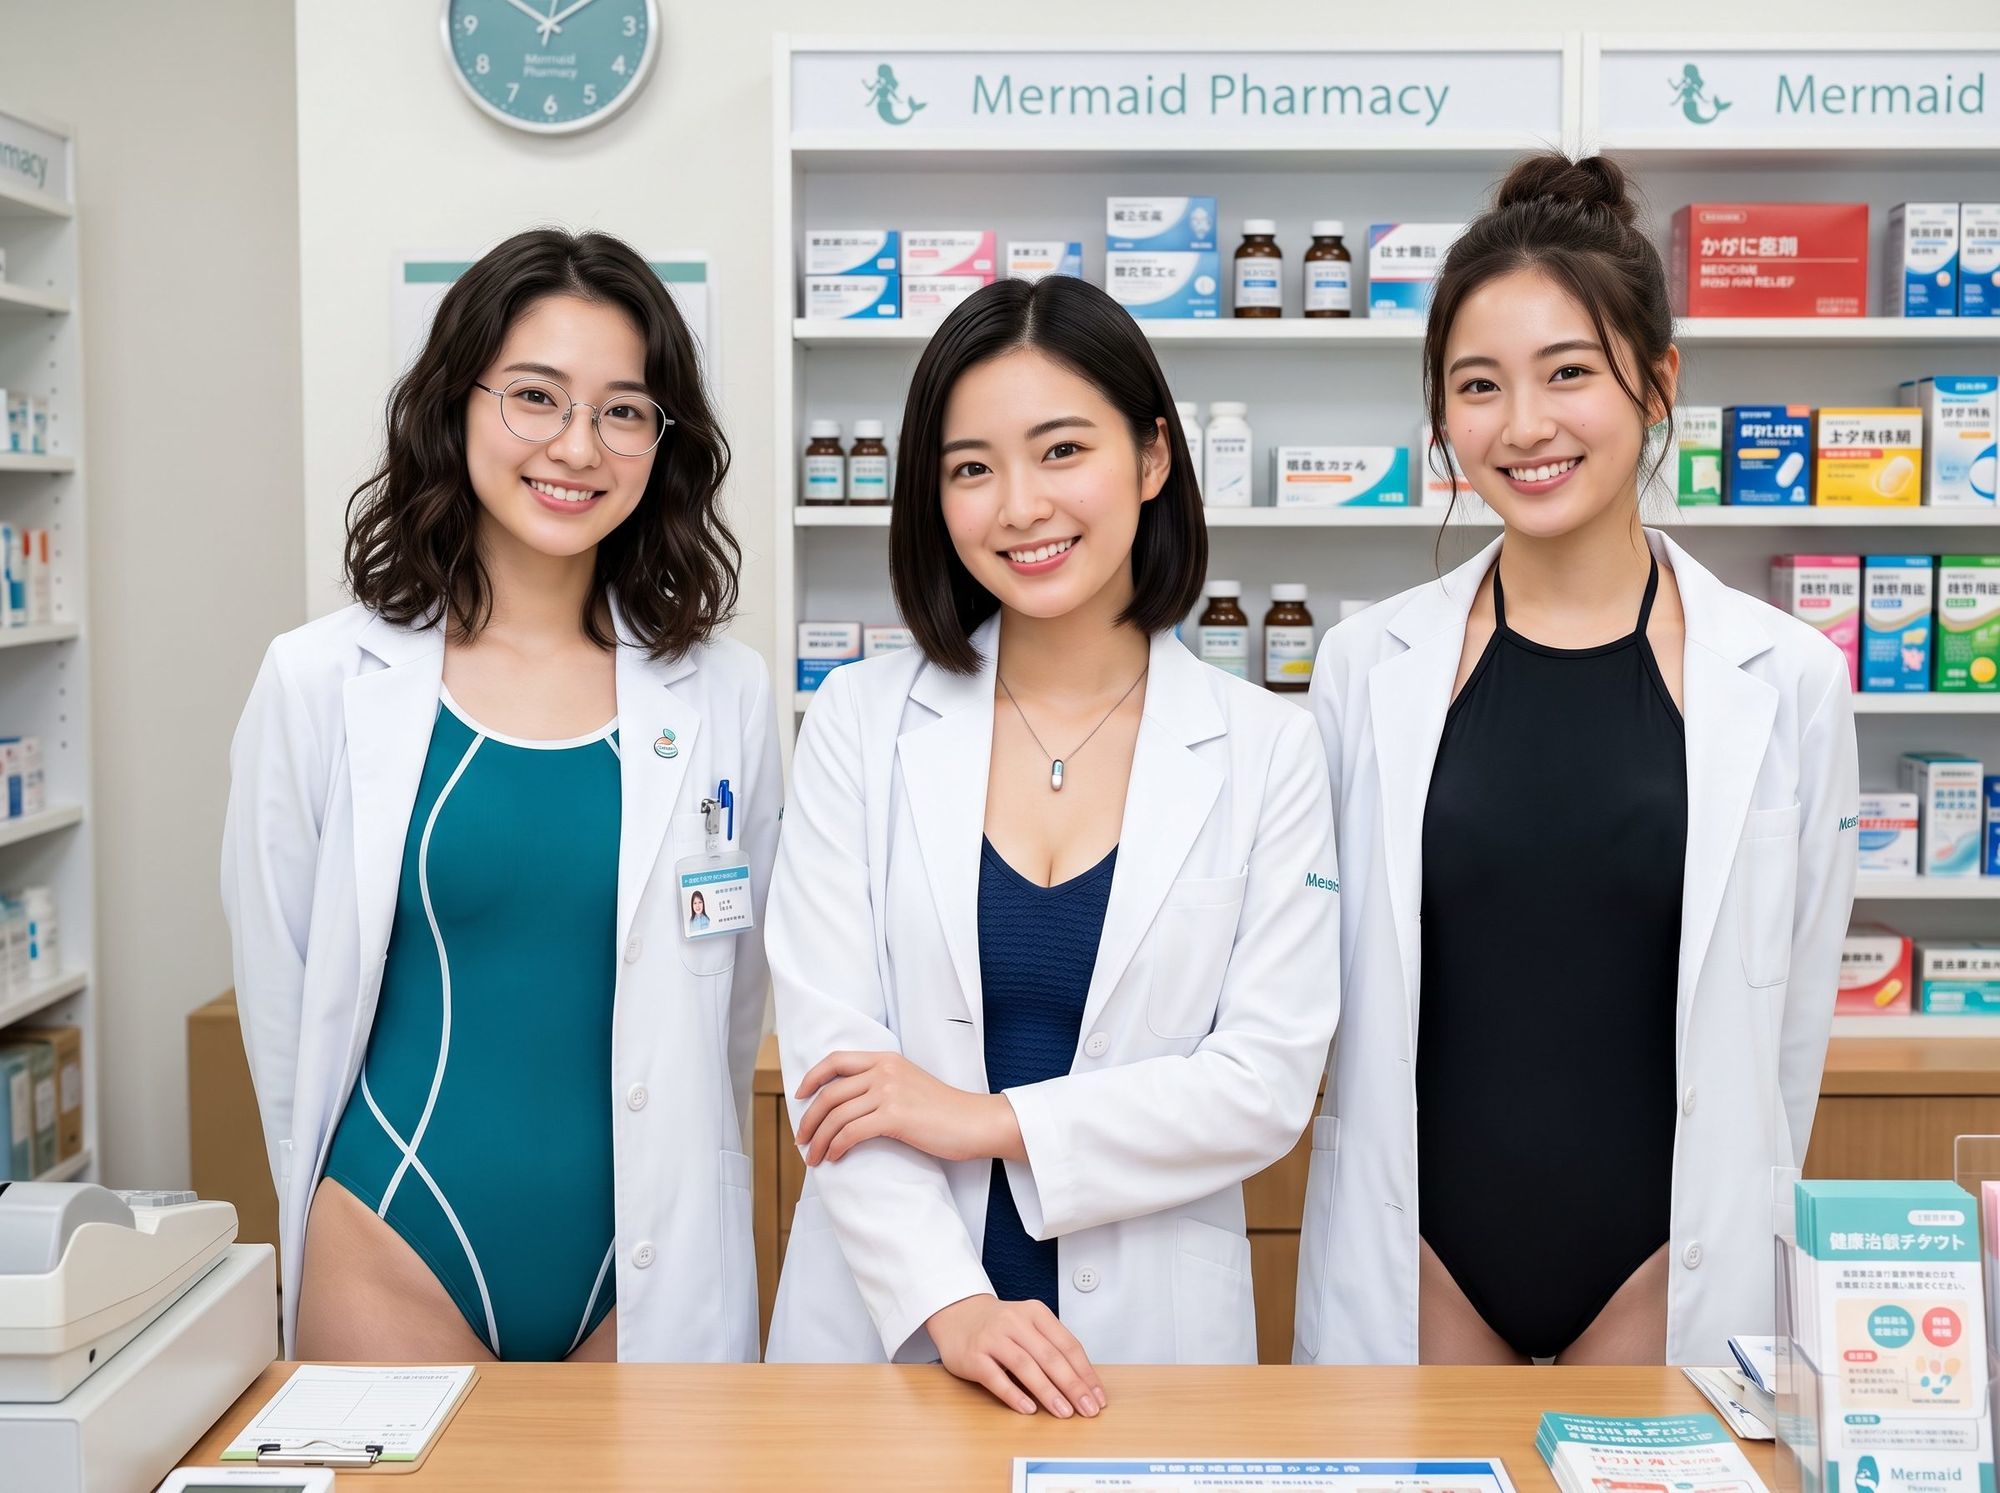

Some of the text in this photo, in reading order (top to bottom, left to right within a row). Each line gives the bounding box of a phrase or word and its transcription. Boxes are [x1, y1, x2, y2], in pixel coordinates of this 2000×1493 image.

[463, 15, 478, 35] 9
[622, 16, 637, 37] 3
[476, 54, 490, 74] 8
[611, 55, 626, 75] 4
[506, 83, 520, 103] 7
[583, 84, 597, 105] 5
[972, 74, 1450, 126] Mermaid Pharmacy
[1776, 72, 1984, 114] Mermaid
[543, 95, 557, 116] 6
[1890, 1467, 1962, 1481] Mermaid
